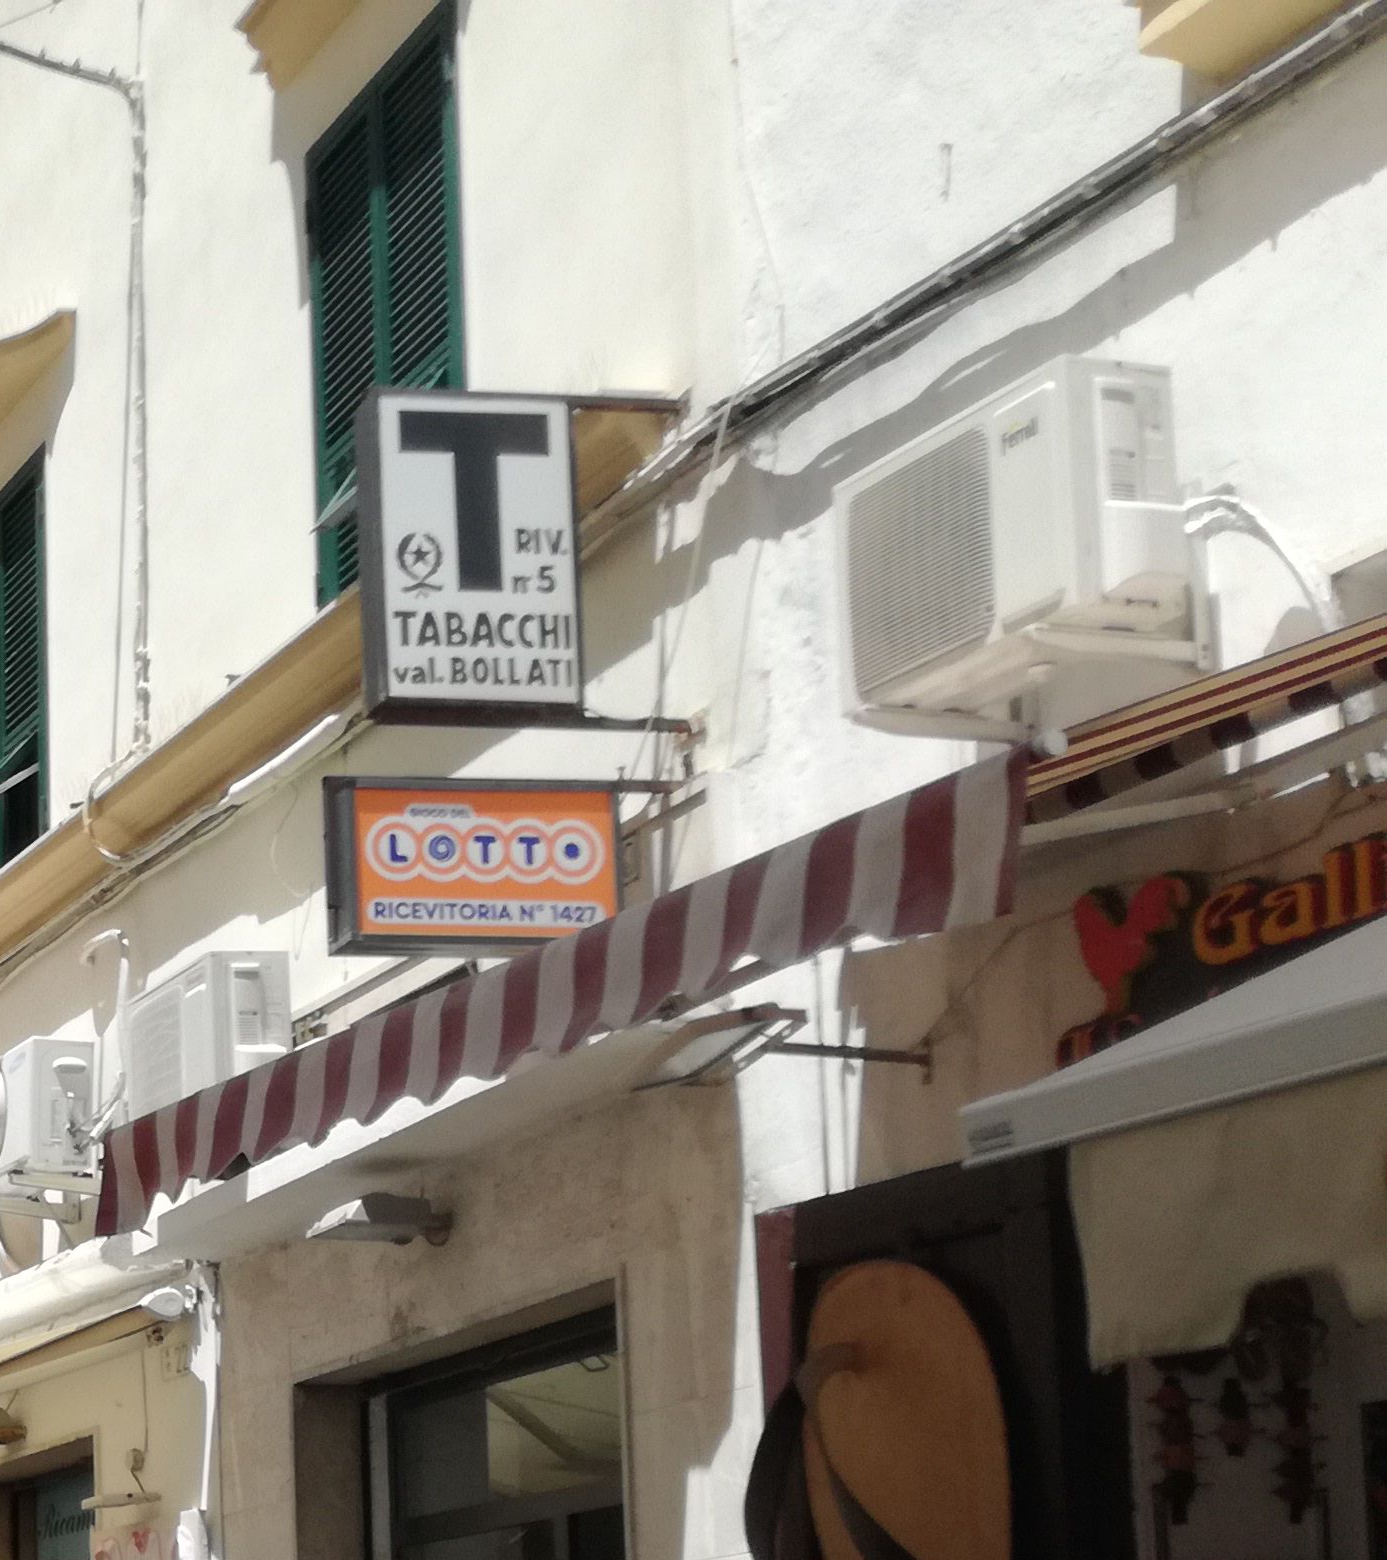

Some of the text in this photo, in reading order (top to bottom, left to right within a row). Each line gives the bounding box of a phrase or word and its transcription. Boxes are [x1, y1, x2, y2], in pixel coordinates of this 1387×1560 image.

[399, 411, 549, 591] T
[514, 528, 568, 555] RIV.
[393, 611, 573, 651] TABACCHI
[393, 656, 574, 688] val. BOLLATI
[387, 832, 582, 866] LOTTO
[374, 901, 513, 921] RICEVITORIA
[552, 905, 598, 924] 1427
